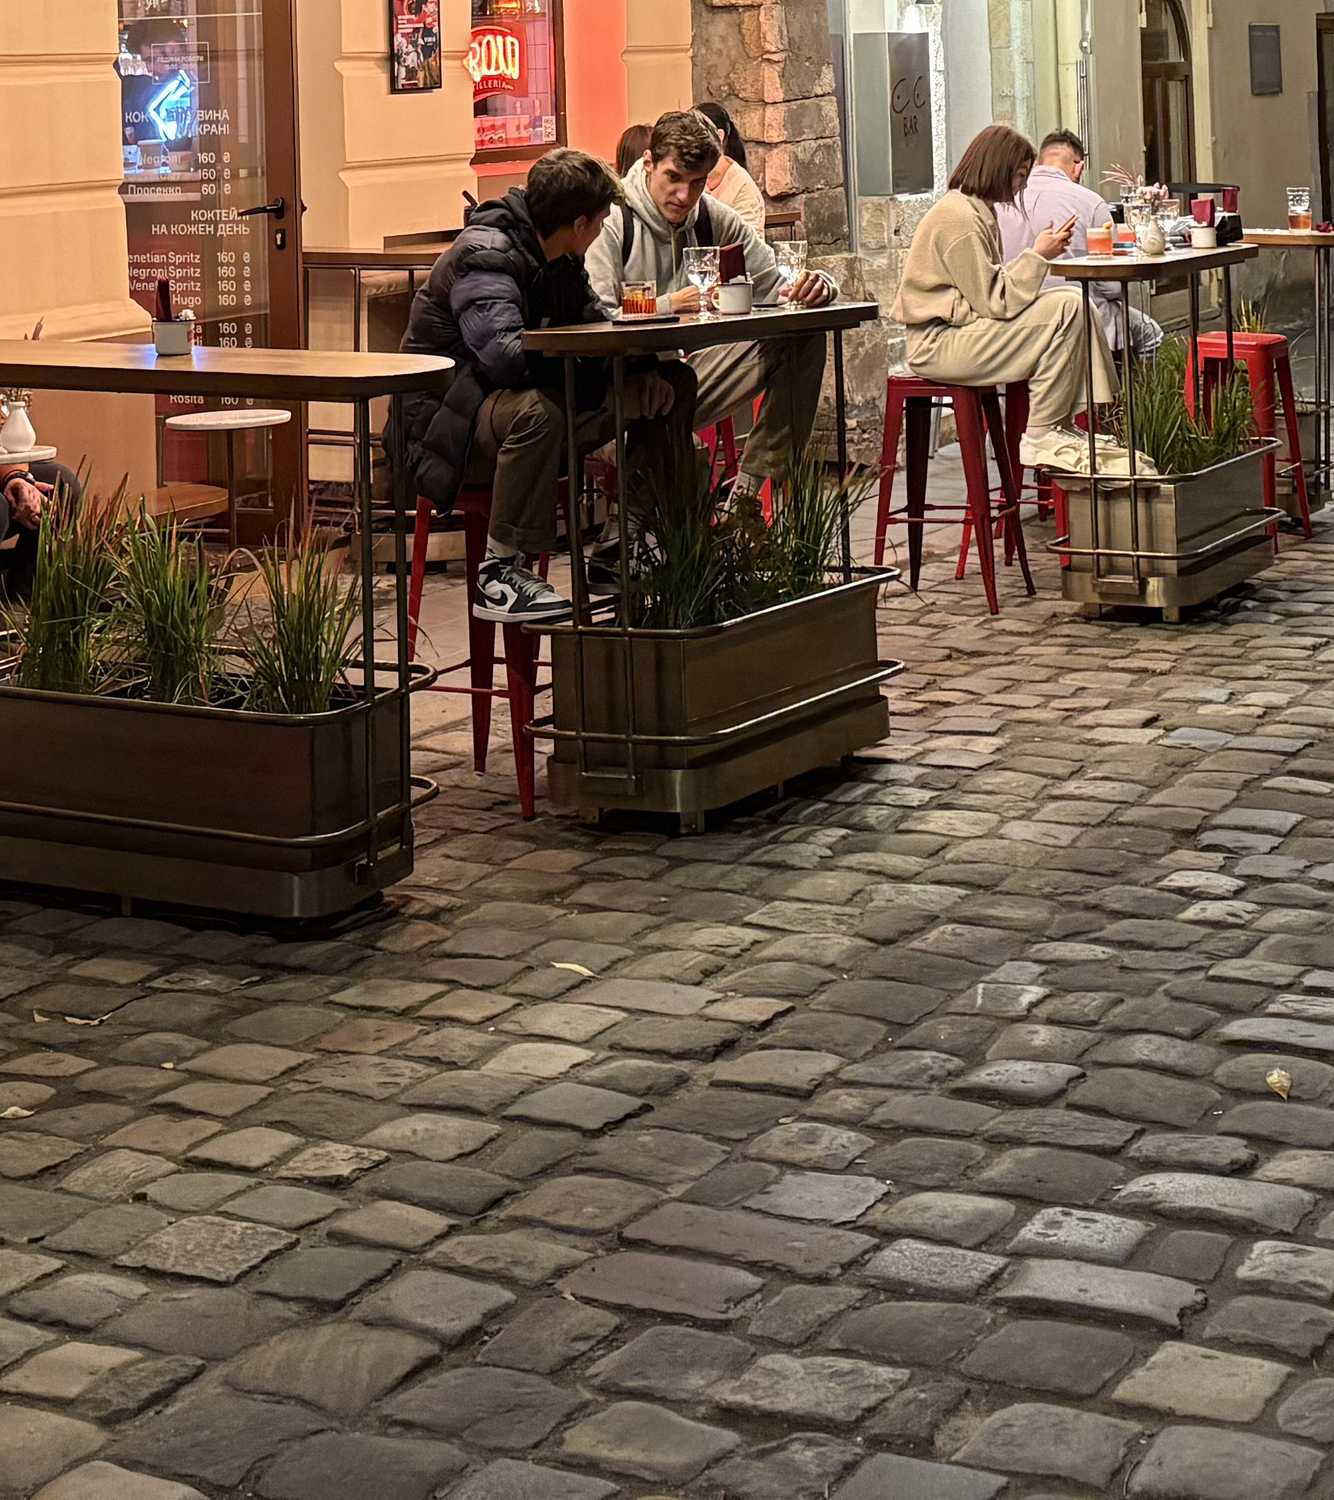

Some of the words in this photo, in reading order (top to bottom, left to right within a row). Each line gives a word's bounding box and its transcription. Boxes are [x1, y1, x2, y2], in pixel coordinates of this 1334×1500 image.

[903, 115, 919, 137] BAR
[197, 152, 216, 163] 160
[197, 168, 216, 179] 160
[201, 184, 216, 194] 60
[151, 224, 168, 235] НА
[170, 224, 214, 235] КОЖЕН
[216, 223, 250, 237] ДЕНЬ
[128, 252, 167, 263] enetian
[167, 251, 201, 265] Spritz
[217, 252, 236, 263] 160
[168, 265, 201, 279] Spritz
[217, 266, 236, 277] 160
[169, 280, 201, 293] Spritz
[217, 280, 236, 291] 160
[172, 293, 202, 307] Hugo
[218, 294, 237, 306] 160
[218, 322, 237, 334] 160
[219, 337, 238, 348] 160
